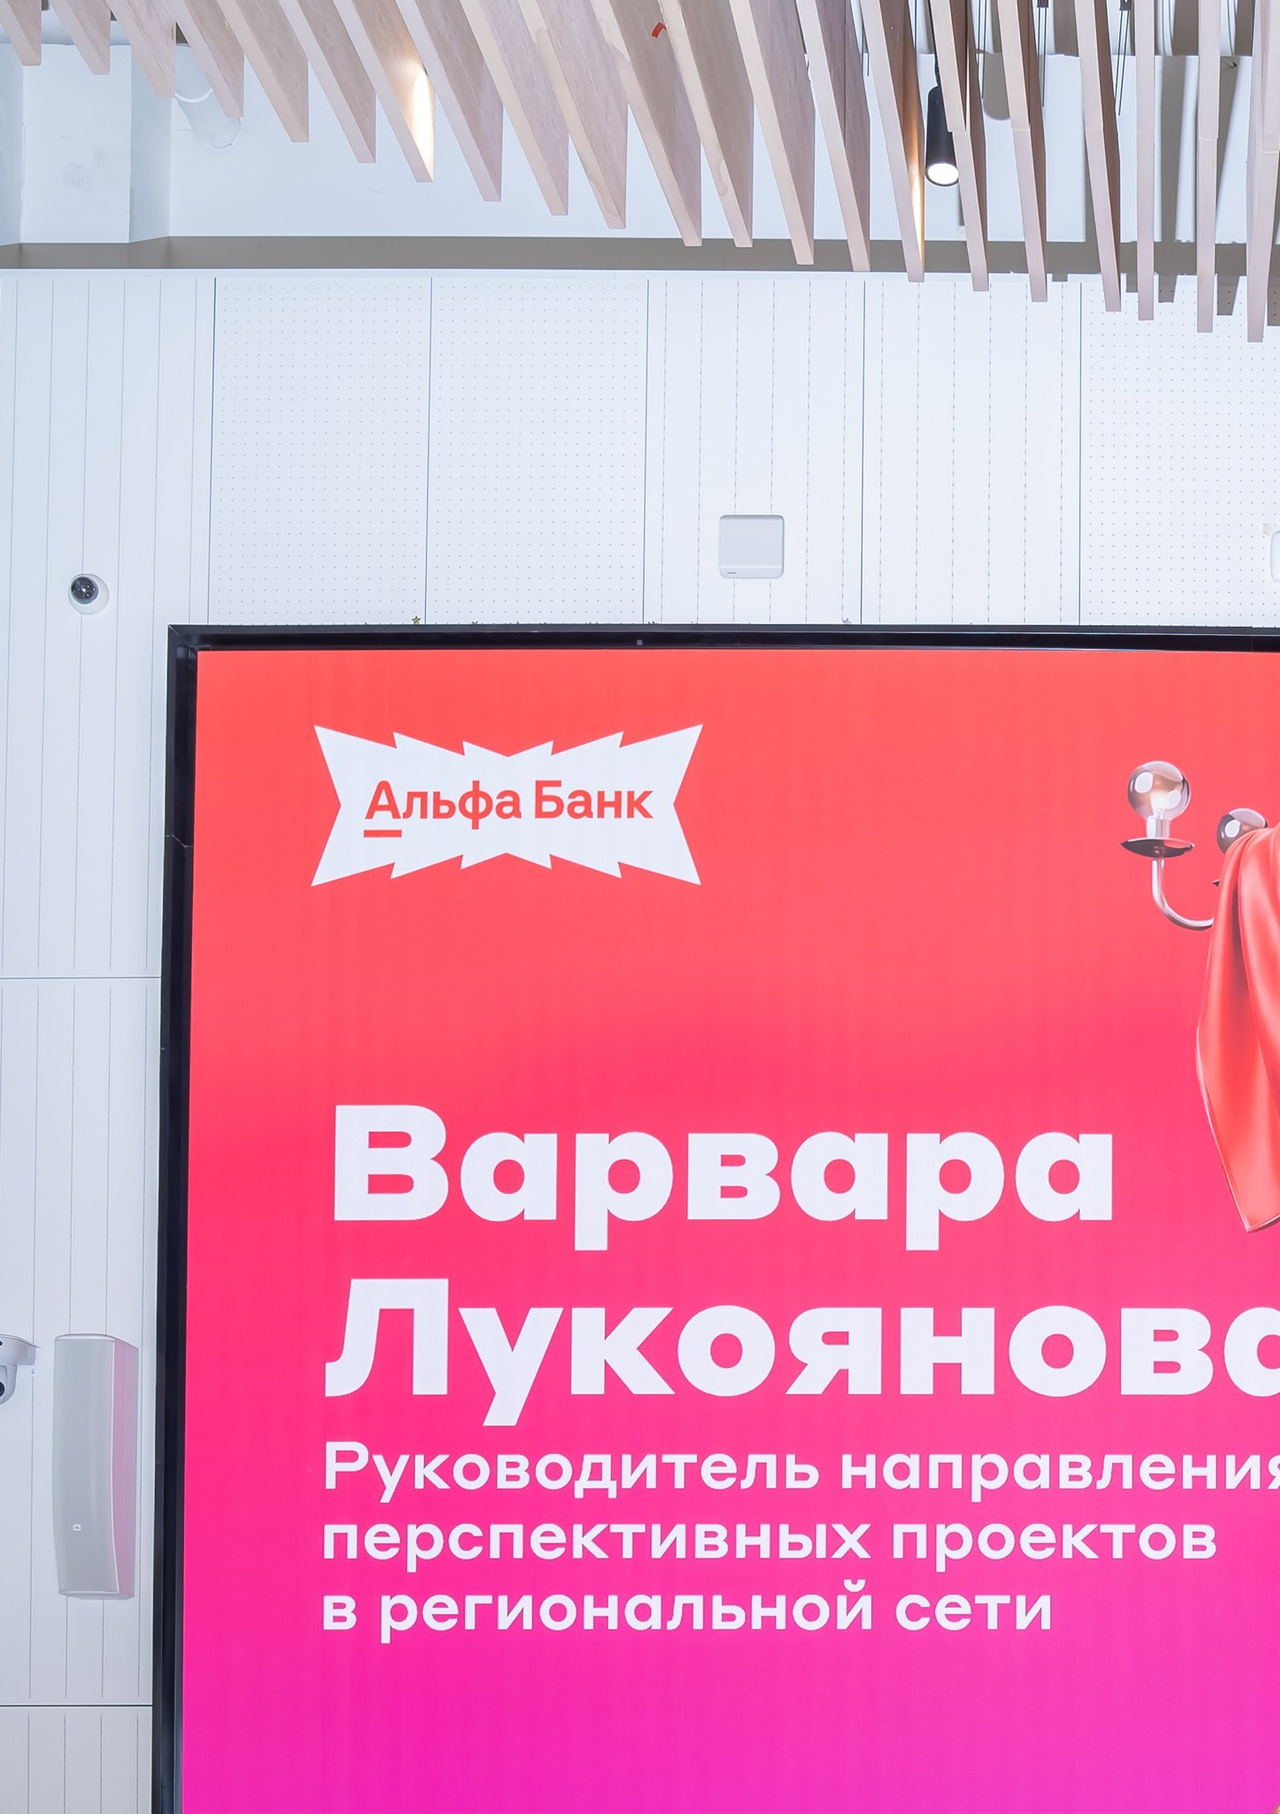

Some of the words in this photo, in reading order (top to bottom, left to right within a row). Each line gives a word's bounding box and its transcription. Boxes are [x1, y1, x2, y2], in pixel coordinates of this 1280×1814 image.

[364, 779, 522, 831] Альфа
[534, 779, 654, 820] Банк
[333, 1104, 1113, 1251] Варвара
[325, 1441, 820, 1500] Руководитель
[323, 1523, 871, 1573] перспективных
[892, 1522, 1217, 1571] проектов
[323, 1595, 357, 1630] в
[380, 1579, 872, 1644] региональной
[895, 1594, 1051, 1631] сети
